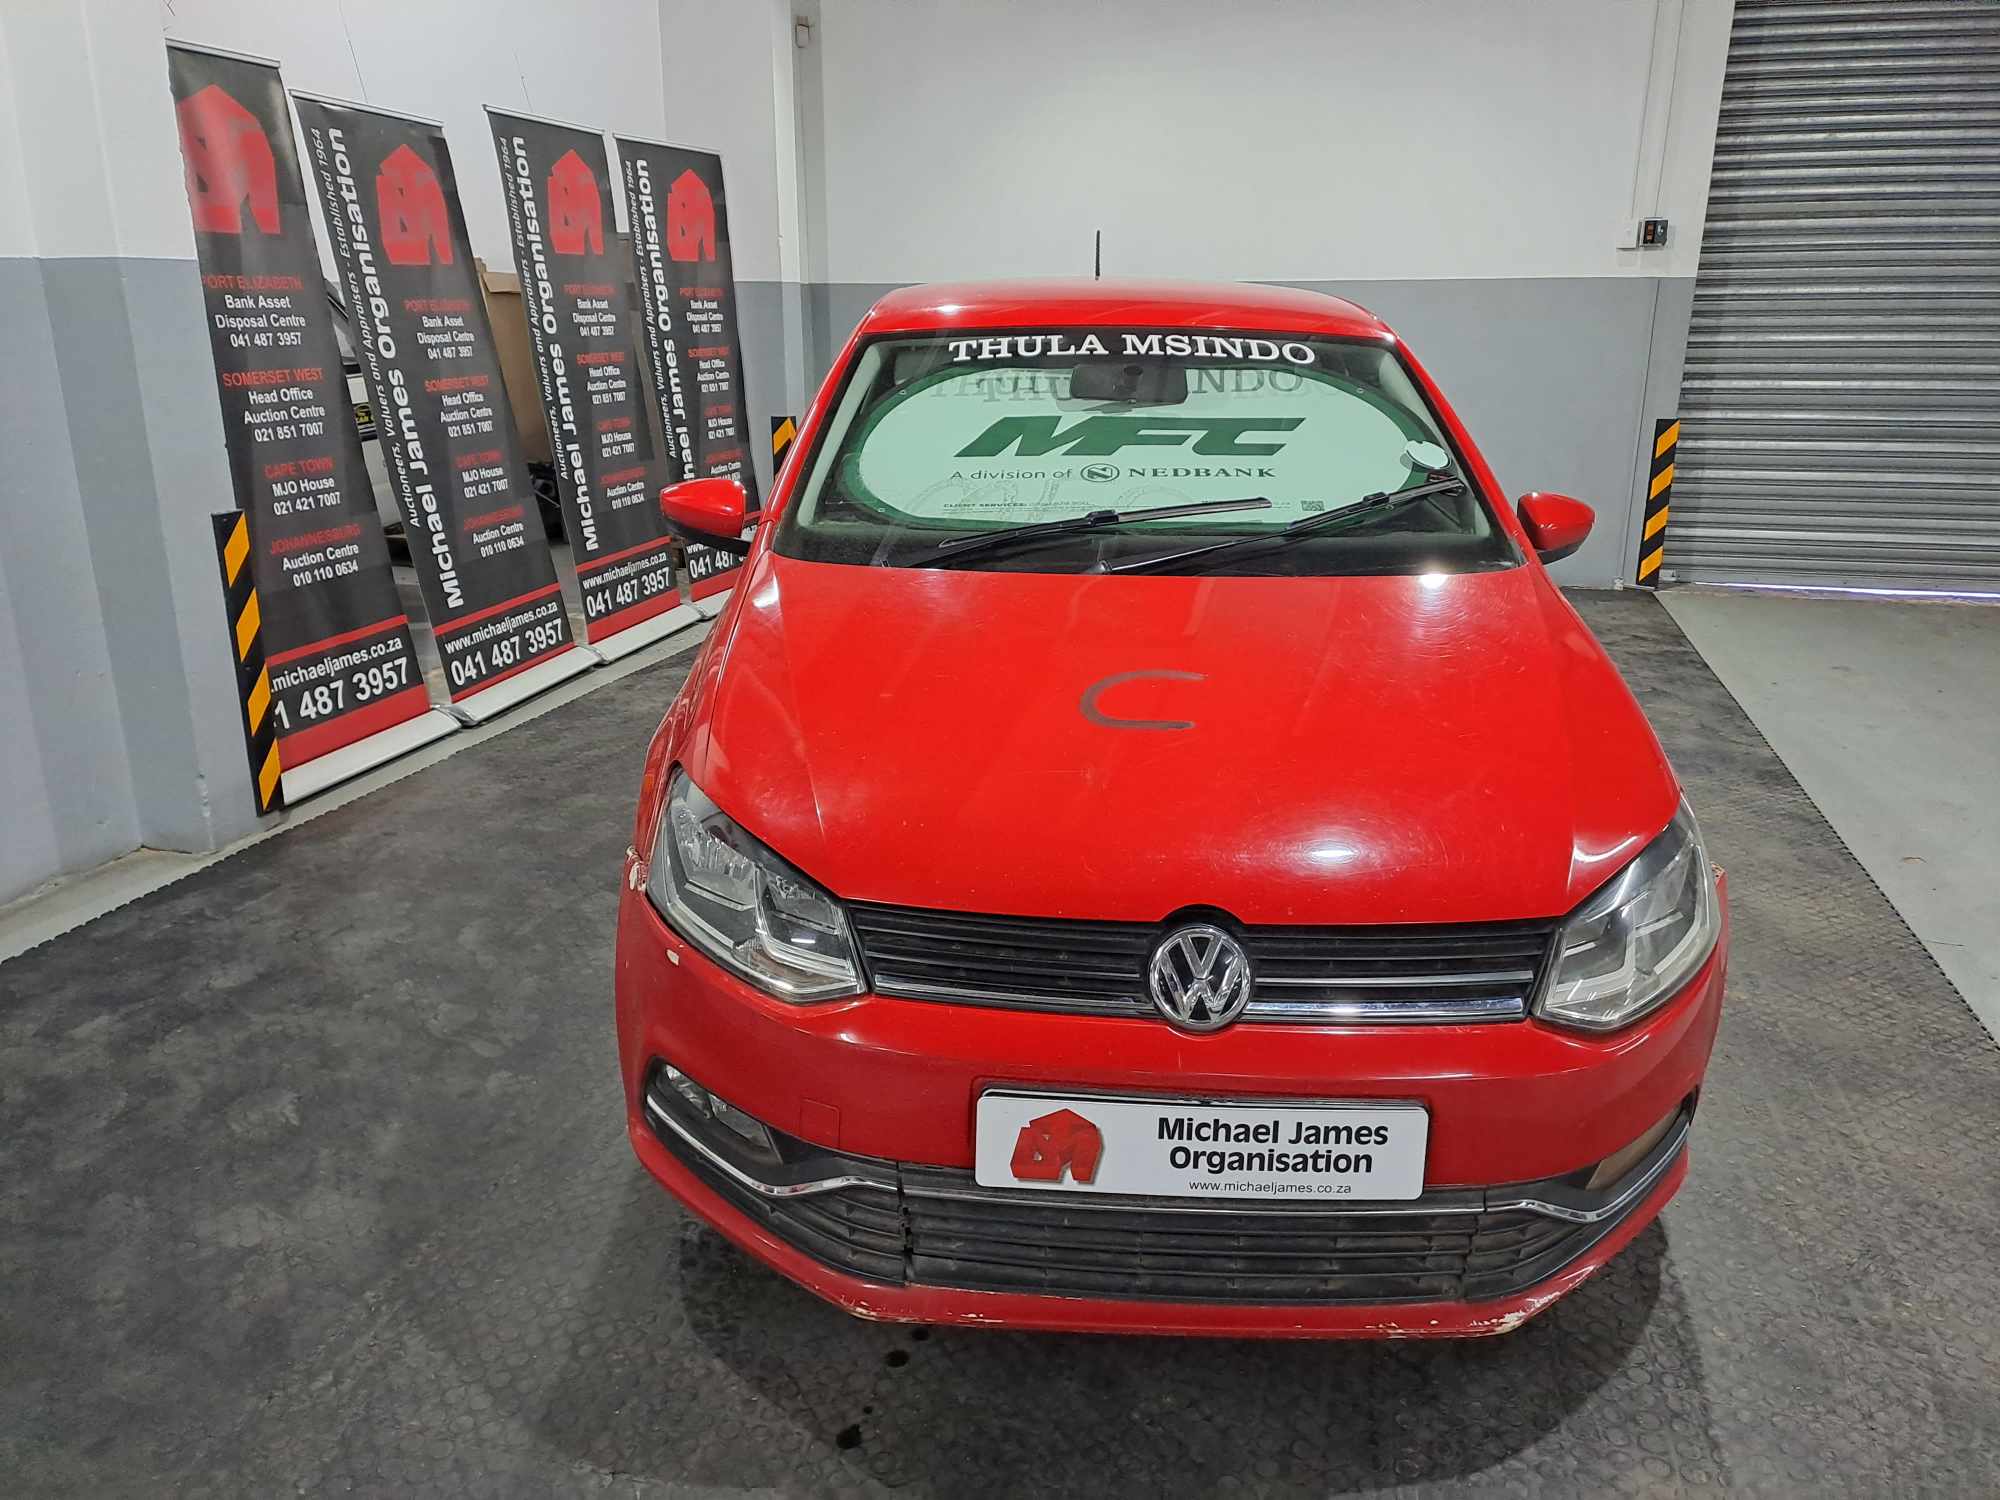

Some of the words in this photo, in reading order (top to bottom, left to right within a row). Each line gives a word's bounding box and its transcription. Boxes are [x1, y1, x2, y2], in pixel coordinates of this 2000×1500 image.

[311, 128, 328, 172] 1964
[499, 136, 512, 170] 1964
[624, 160, 636, 190] 1964
[320, 174, 351, 259] Established
[507, 173, 525, 248] Established
[629, 191, 645, 257] Established
[328, 128, 396, 359] Organisation
[512, 136, 557, 335] Organisation
[636, 159, 672, 332] Organisation
[202, 275, 236, 289] ORT
[521, 260, 540, 324] Appraisers
[639, 265, 655, 325] Appraisers
[225, 294, 256, 309] Bank
[258, 296, 291, 308] Asset
[349, 272, 374, 349] Appraisers
[215, 314, 268, 331] Disposal
[270, 314, 306, 327] Centre
[422, 315, 443, 328] Bank
[230, 333, 251, 347] 041
[254, 333, 273, 346] 487
[277, 332, 301, 346] 3957
[417, 331, 452, 346] Disposal
[452, 331, 475, 342] Centre
[531, 325, 544, 353] and
[646, 326, 659, 348] and
[949, 334, 1110, 362] THULA
[1121, 334, 1315, 364] MSINDO
[366, 352, 381, 380] and
[427, 348, 441, 360] 041
[223, 369, 290, 386] SOMERSET
[292, 368, 322, 381] WEST
[539, 355, 553, 401] Valuers
[653, 350, 665, 390] Valuers
[663, 338, 686, 420] James
[248, 389, 278, 405] Head
[280, 387, 313, 402] Office
[441, 393, 462, 406] Head
[462, 392, 484, 404] Office
[549, 343, 577, 436] James
[244, 410, 288, 424] Auction
[291, 405, 326, 419] Centre
[375, 384, 396, 437] Valuers
[388, 368, 429, 475] James
[440, 410, 470, 423] Auction
[470, 407, 493, 418] Centre
[660, 393, 677, 458] Auctioneers,
[254, 428, 274, 442] 021
[276, 425, 297, 439] 851
[299, 422, 324, 437] 7007
[447, 425, 461, 438] 021
[549, 405, 569, 480] Auctioneers,
[953, 416, 1306, 457] MFC
[272, 481, 298, 497] MJO
[300, 476, 335, 492] House
[391, 441, 421, 527] Auctioneers,
[462, 469, 479, 482] MJO
[479, 467, 504, 480] House
[950, 470, 964, 480] A
[969, 468, 1046, 481] division
[1050, 468, 1073, 480] of
[1129, 466, 1276, 478] NEDBANK
[273, 501, 293, 516] 021
[295, 497, 315, 512] 421
[317, 491, 341, 508] 7007
[565, 443, 600, 552] Michael
[415, 484, 464, 608] Michael
[472, 529, 500, 544] Auction
[500, 522, 524, 536] Centre
[282, 553, 325, 571] Auction
[327, 543, 359, 561] Centre
[582, 551, 667, 590] www.michaeljames.co.za
[690, 554, 712, 579] 041
[293, 572, 312, 587] 010
[314, 566, 333, 582] 110
[335, 559, 359, 577] 0634
[586, 588, 613, 617] 041
[616, 578, 638, 606] 487
[641, 567, 670, 596] 3957
[444, 601, 558, 654] www.michaeljames.co.za
[450, 650, 487, 686] 041
[491, 635, 521, 668] 487
[525, 618, 563, 654] 3957
[299, 679, 344, 719] 487
[352, 656, 407, 701] 3957
[1158, 1117, 1280, 1144] Michael
[1288, 1121, 1389, 1146] James
[1169, 1145, 1373, 1175] Organisation
[1189, 1180, 1352, 1195] www.michaeljames.co.za
